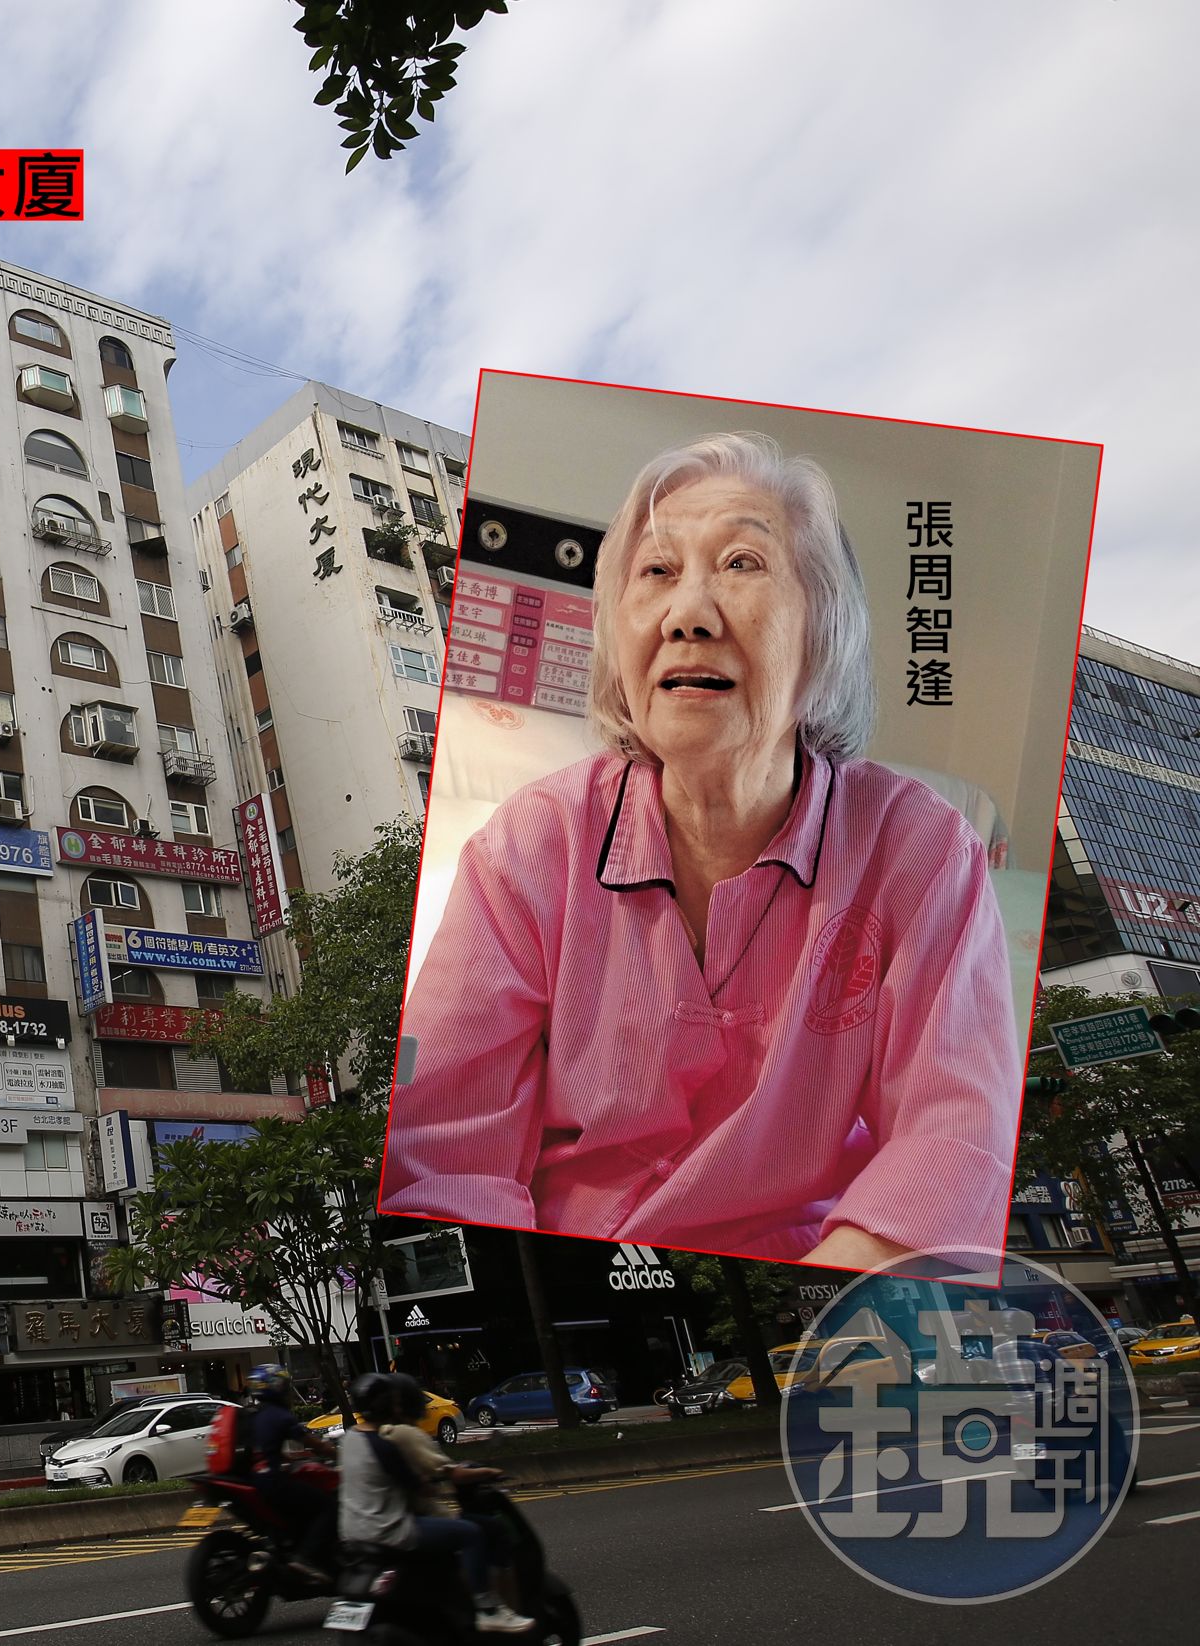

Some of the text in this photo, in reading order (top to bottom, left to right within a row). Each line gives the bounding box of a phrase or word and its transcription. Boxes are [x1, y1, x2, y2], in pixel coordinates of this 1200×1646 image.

[1117, 885, 1176, 922] U2
[260, 909, 278, 923] 7F
[131, 950, 238, 969] www.six.com.tw
[1062, 1013, 1139, 1038] 忠孝東路四段181巷
[1070, 1031, 1147, 1056] 忠孝東路四段170巷
[1, 1119, 18, 1133] 3F
[106, 1203, 114, 1211] 2F
[608, 1266, 676, 1292] adidas
[190, 1316, 254, 1337] swatch
[405, 1318, 430, 1328] adidas
